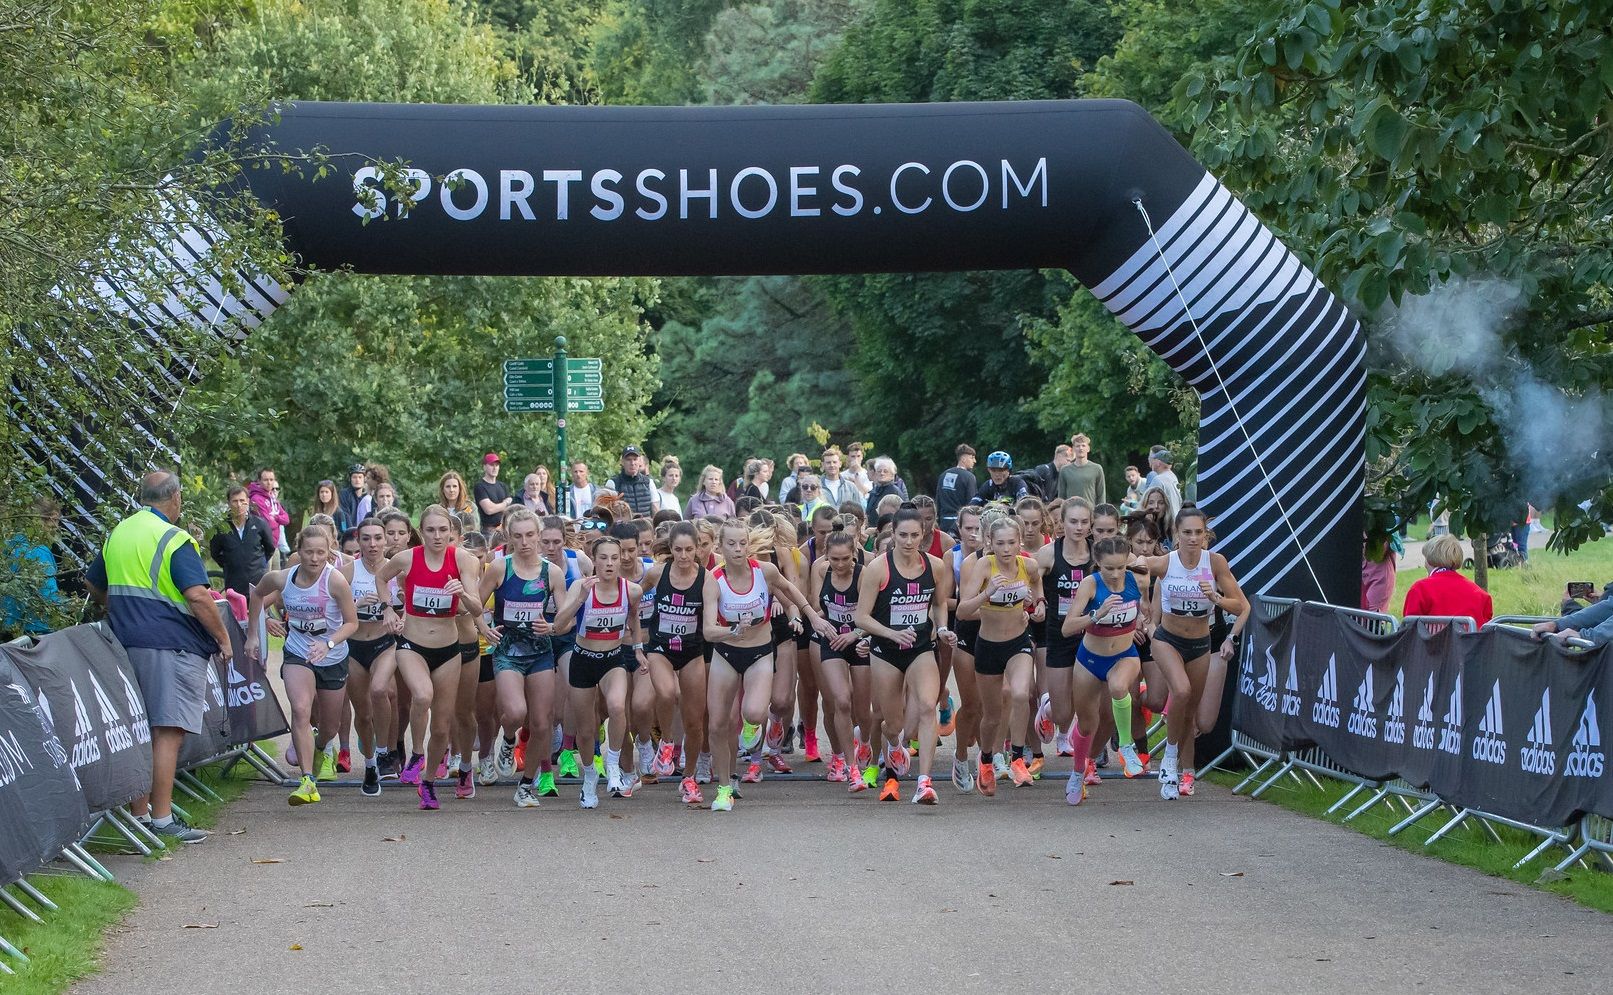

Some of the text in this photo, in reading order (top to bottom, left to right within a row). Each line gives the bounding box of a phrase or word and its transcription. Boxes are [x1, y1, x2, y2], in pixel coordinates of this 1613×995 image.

[351, 156, 1048, 221] SPORTSSHOES.COM
[1057, 581, 1081, 589] POD
[1167, 584, 1201, 592] ENGLAN
[889, 594, 932, 604] PODIUM
[1003, 592, 1018, 601] 196
[425, 597, 440, 608] 161
[1182, 600, 1198, 610] 153
[286, 604, 324, 614] ENGLAND
[657, 603, 696, 615] PODIUM
[514, 611, 531, 621] 421
[837, 613, 852, 622] 180
[902, 614, 919, 624] 206
[1112, 612, 1127, 623] 157
[300, 620, 315, 631] 162
[597, 617, 613, 627] 201
[671, 623, 686, 635] 160
[580, 650, 604, 659] PRO
[1312, 698, 1340, 728] adidas
[1347, 710, 1377, 739] adidas
[72, 732, 101, 768] adidas
[1472, 731, 1506, 765] adidas
[1520, 742, 1556, 776] adidas
